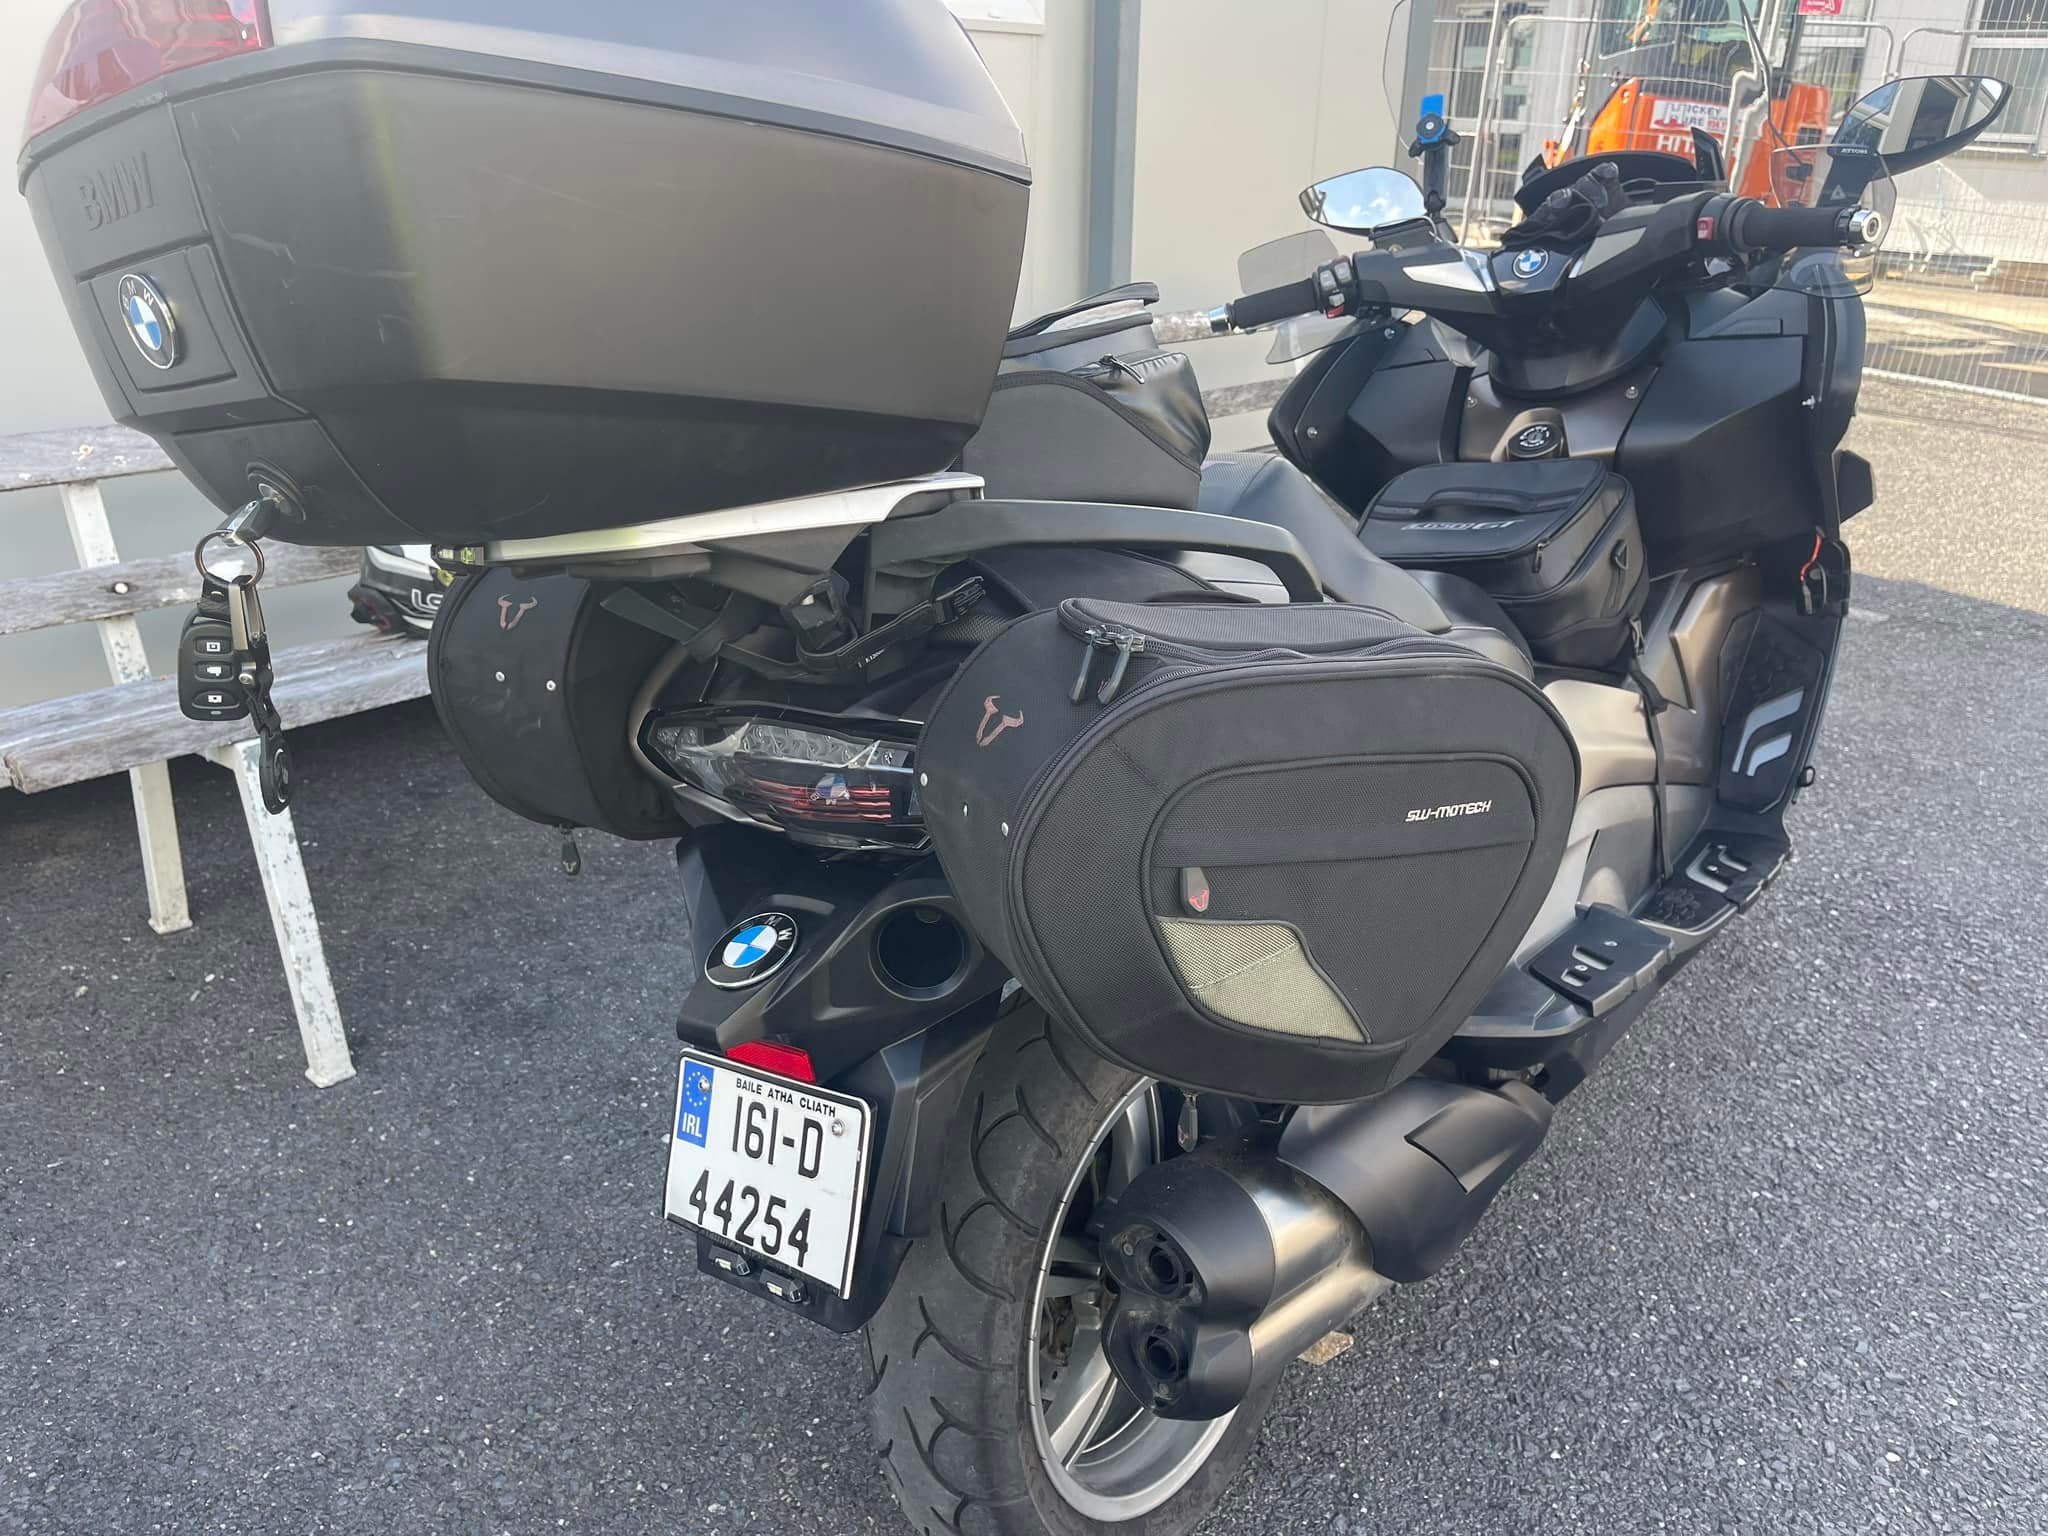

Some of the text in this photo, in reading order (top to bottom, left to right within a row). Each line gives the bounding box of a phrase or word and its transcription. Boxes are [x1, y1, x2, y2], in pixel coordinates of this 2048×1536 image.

[80, 150, 155, 231] BMW
[1405, 800, 1492, 822] SW-MOTECH
[682, 1112, 703, 1138] IRL
[736, 1078, 836, 1118] BAILE ATHA CLIATH
[732, 1096, 823, 1179] 161-D
[689, 1169, 811, 1268] 44254
